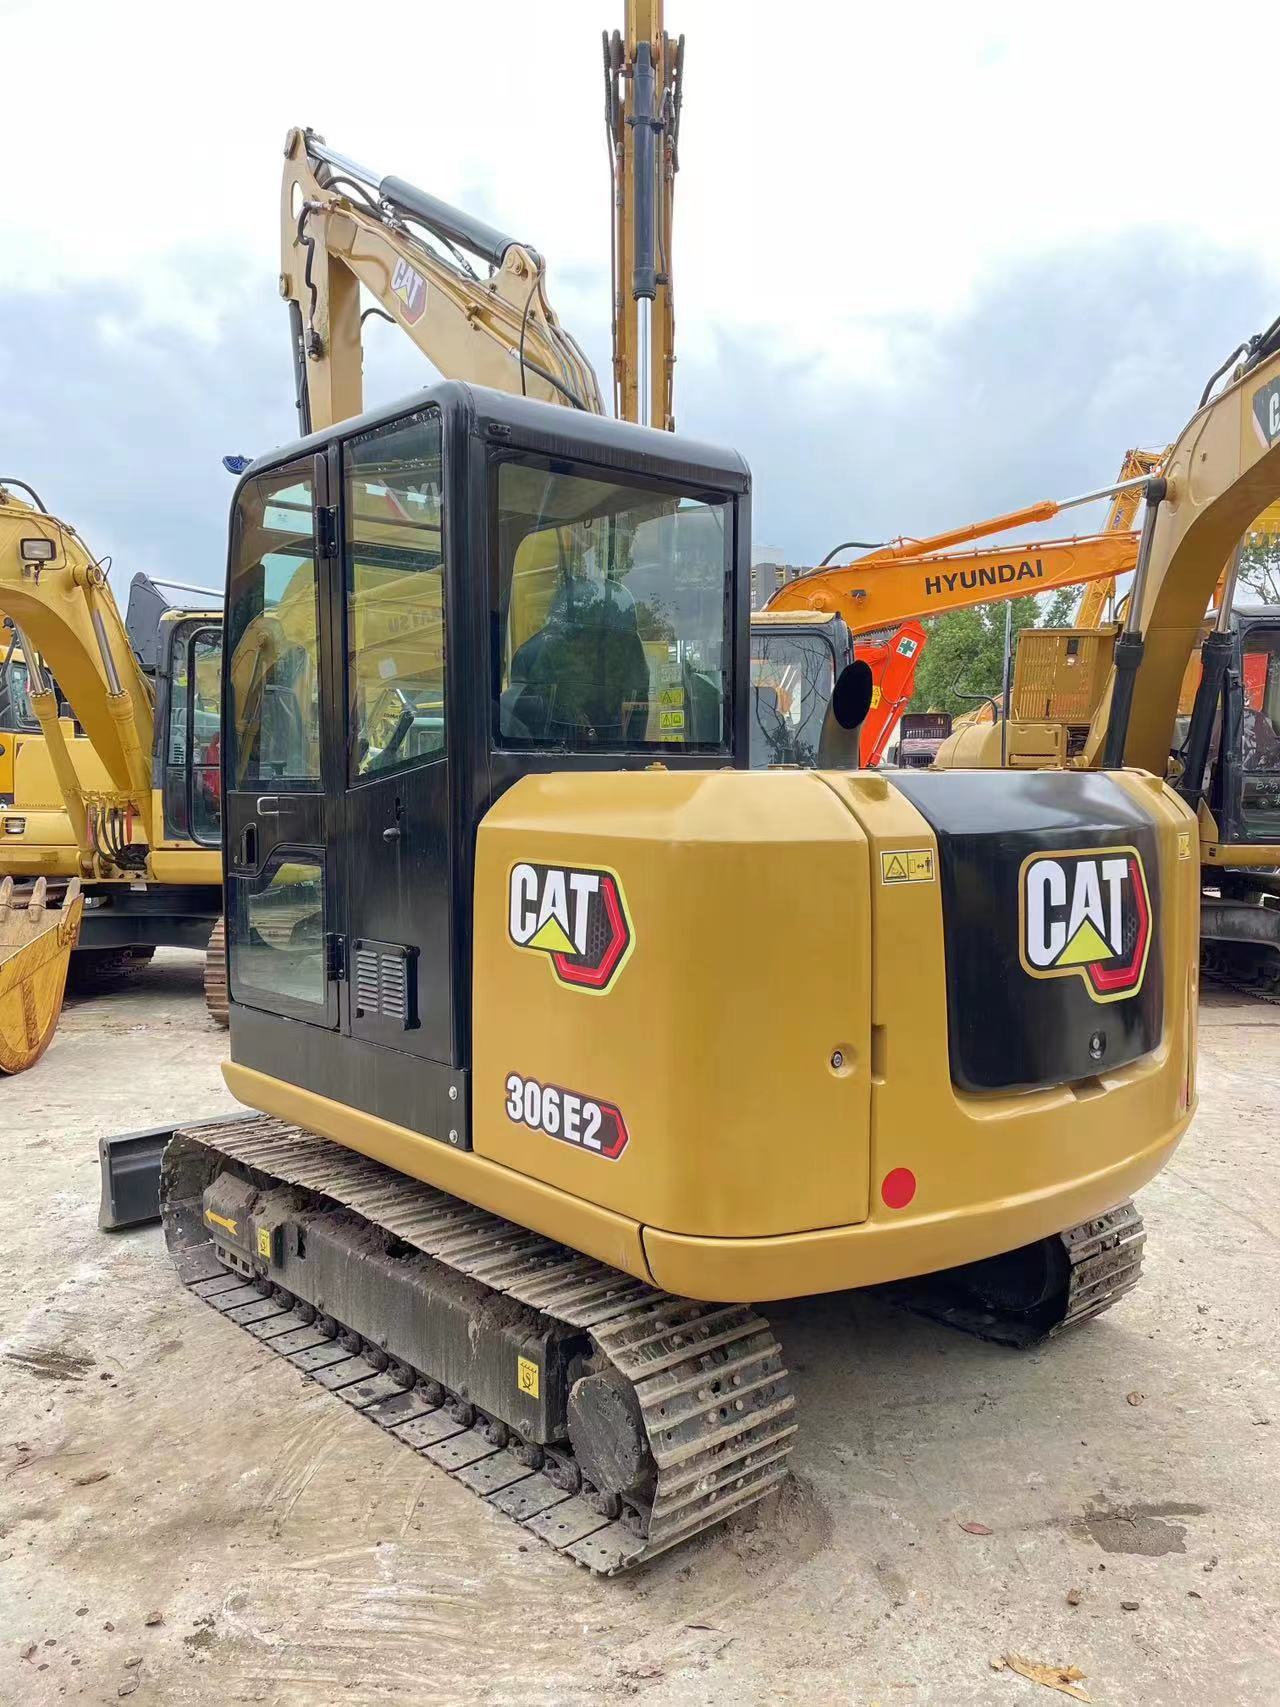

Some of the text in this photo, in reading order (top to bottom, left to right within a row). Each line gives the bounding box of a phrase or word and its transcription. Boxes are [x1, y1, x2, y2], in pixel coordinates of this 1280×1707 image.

[391, 256, 424, 308] CAT
[925, 560, 1043, 595] HYUNDAI
[510, 864, 600, 955] CAT
[1027, 858, 1128, 966] CAT
[507, 1075, 602, 1151] 306E2
